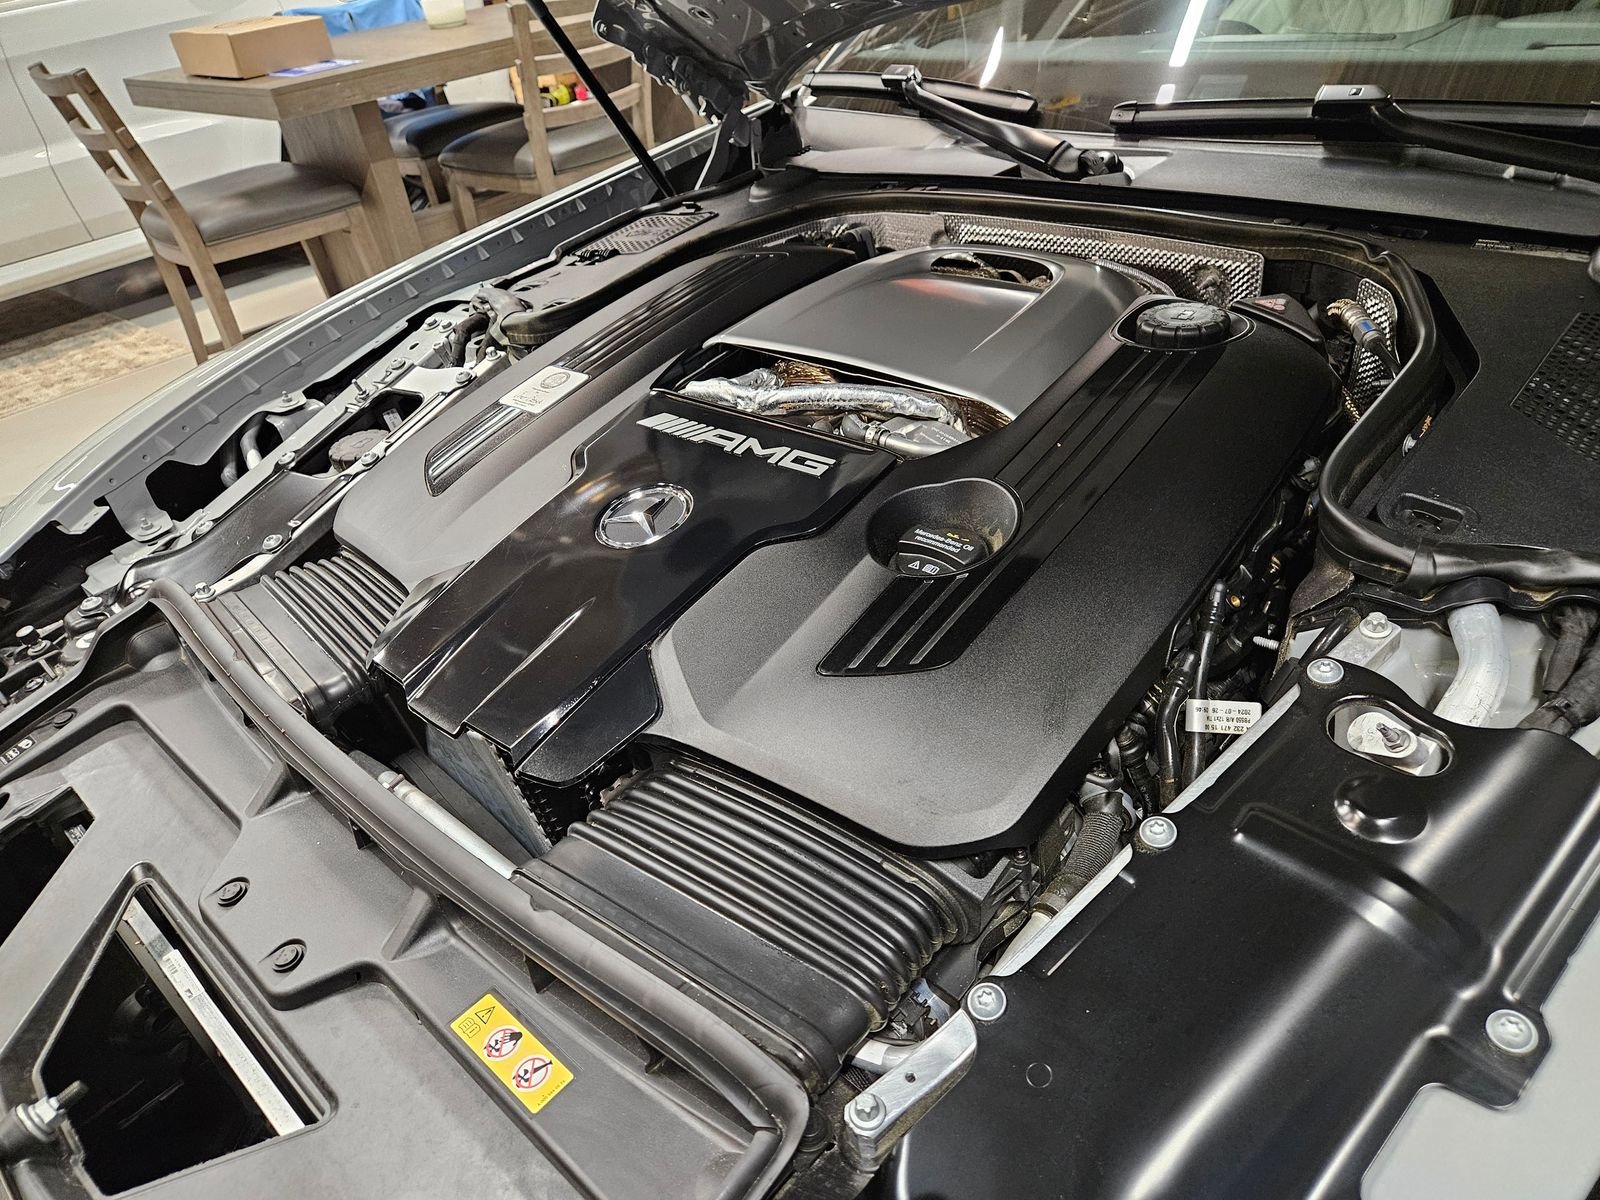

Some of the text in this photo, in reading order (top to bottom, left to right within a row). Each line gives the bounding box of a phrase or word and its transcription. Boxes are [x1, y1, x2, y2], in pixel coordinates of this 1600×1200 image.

[688, 427, 837, 477] AMG
[914, 528, 975, 552] Mercedes-Benz Oil
[914, 535, 961, 553] recommended
